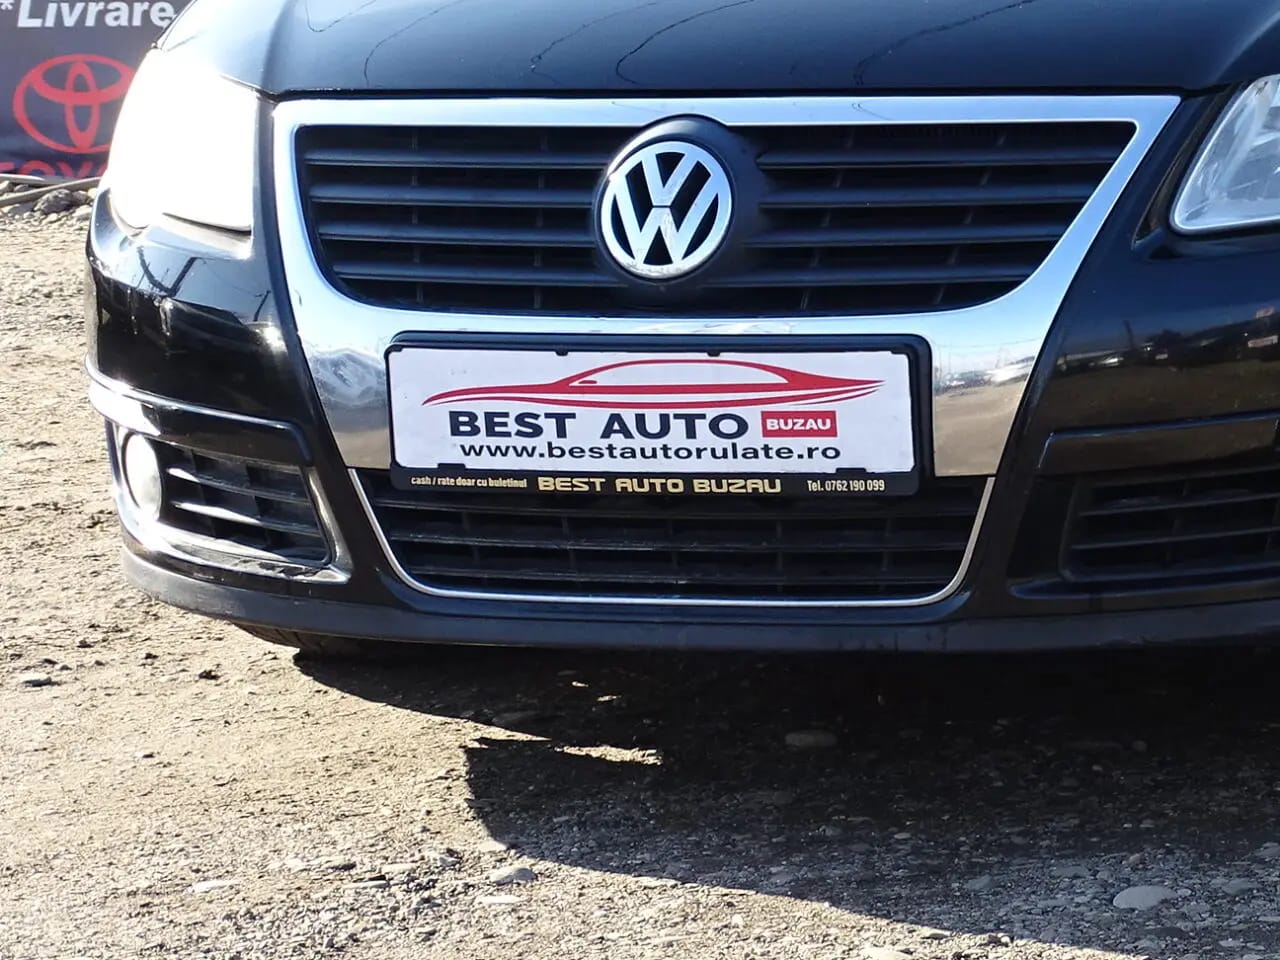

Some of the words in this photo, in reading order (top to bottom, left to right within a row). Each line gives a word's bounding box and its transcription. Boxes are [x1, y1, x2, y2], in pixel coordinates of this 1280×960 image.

[448, 410, 577, 438] BEST
[600, 412, 749, 440] AUTO
[765, 418, 832, 432] BUZAU
[459, 441, 841, 460] www.bestautorulate.ro
[411, 476, 431, 485] cash
[437, 477, 455, 486] rate
[456, 476, 475, 487] doar
[476, 478, 487, 487] cu
[488, 477, 528, 488] buletinul
[537, 476, 605, 491] BEST
[615, 477, 684, 493] AUTO
[692, 478, 781, 493] BUZAU
[807, 480, 823, 491] Tel.
[825, 479, 847, 491] 0762
[849, 479, 865, 491] 190
[866, 479, 885, 491] 099
